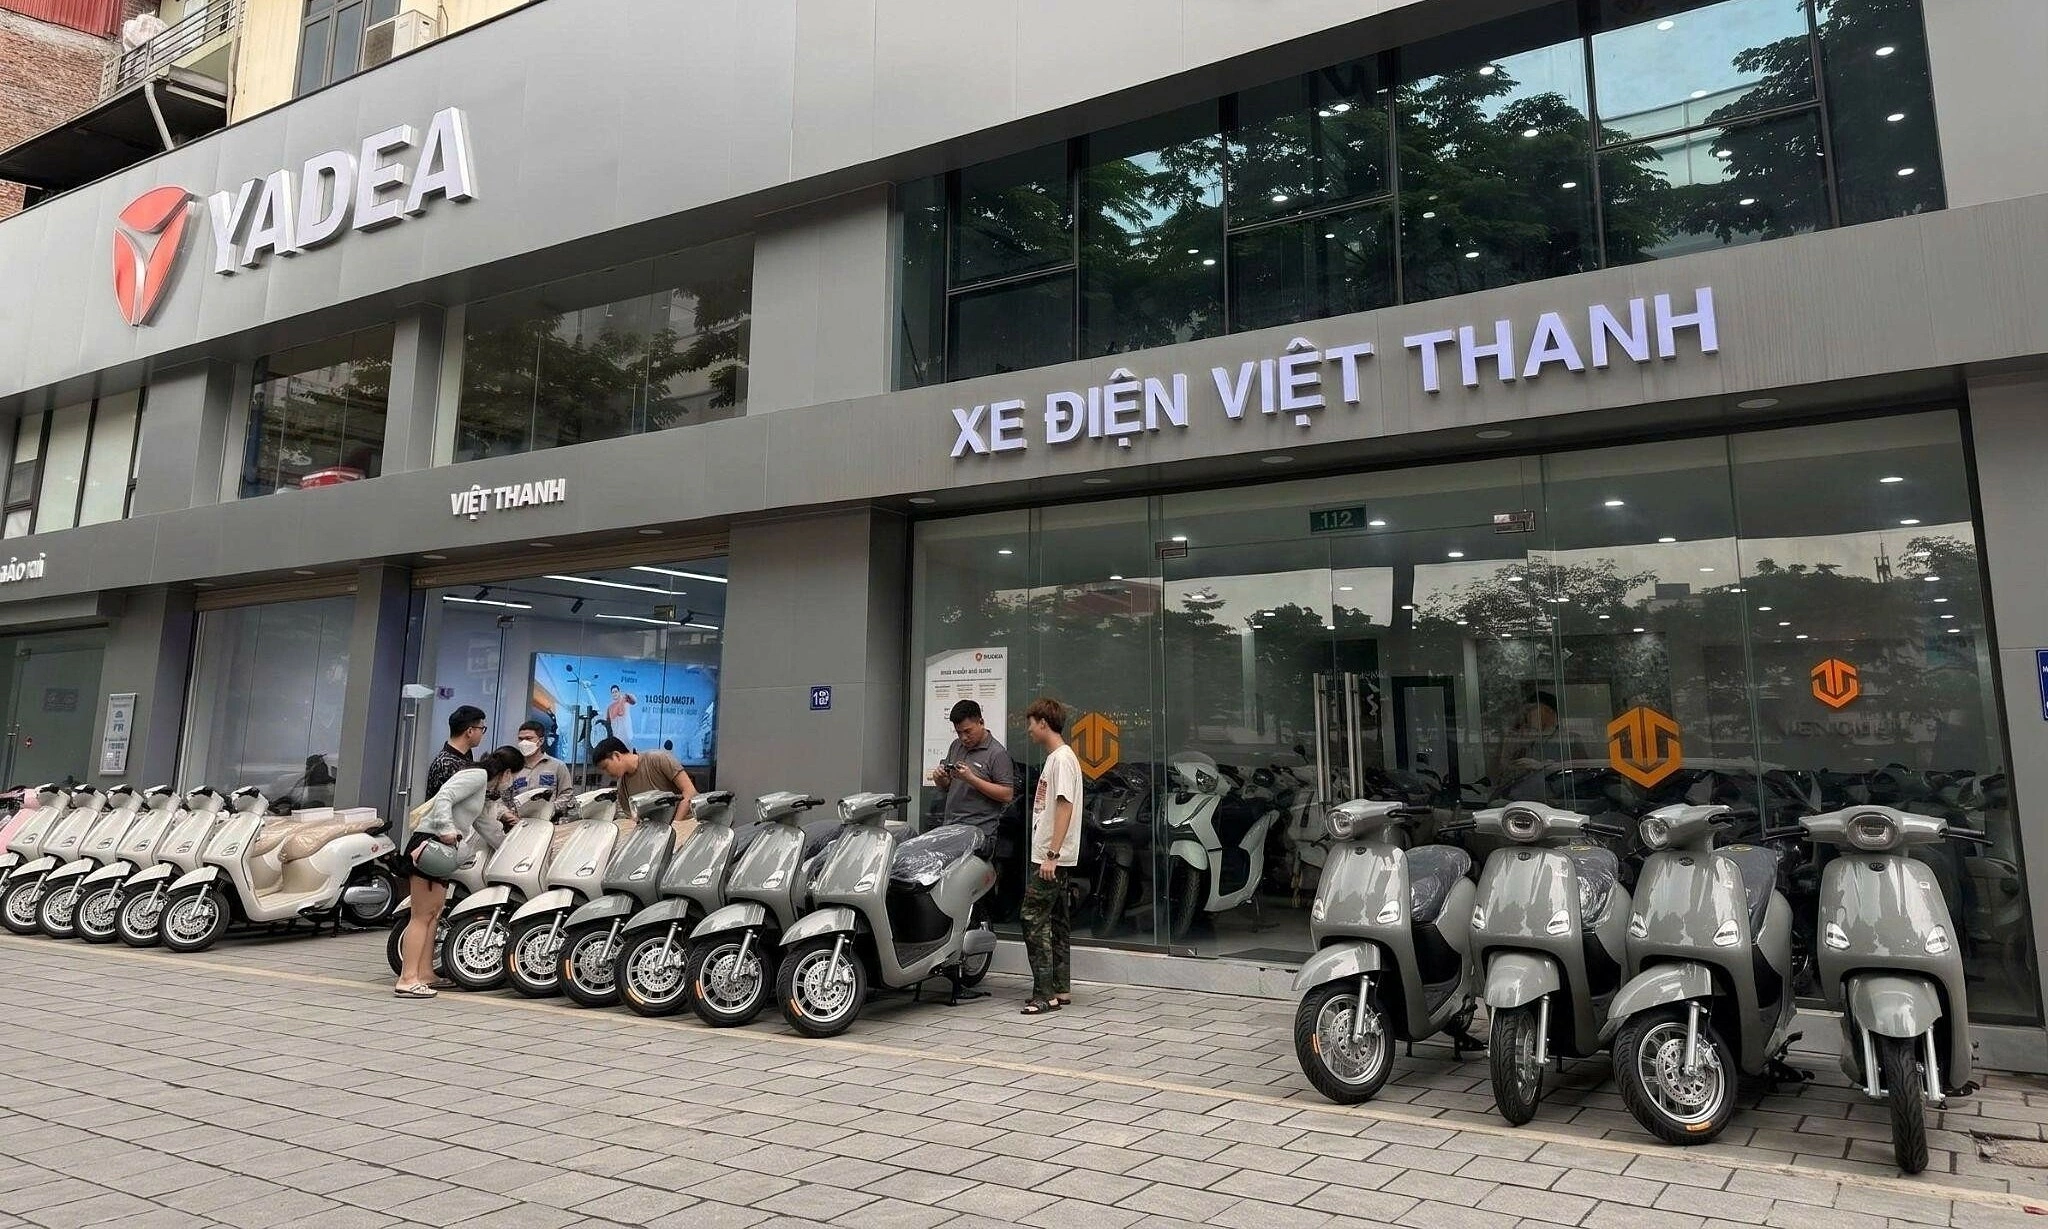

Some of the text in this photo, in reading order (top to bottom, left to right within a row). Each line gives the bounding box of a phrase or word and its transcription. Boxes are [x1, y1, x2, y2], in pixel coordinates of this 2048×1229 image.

[208, 107, 472, 276] YADEA
[950, 286, 1719, 458] XE ĐIỆN VIỆT THANH
[451, 478, 566, 520] VIỆT THANH
[1321, 511, 1354, 528] 112
